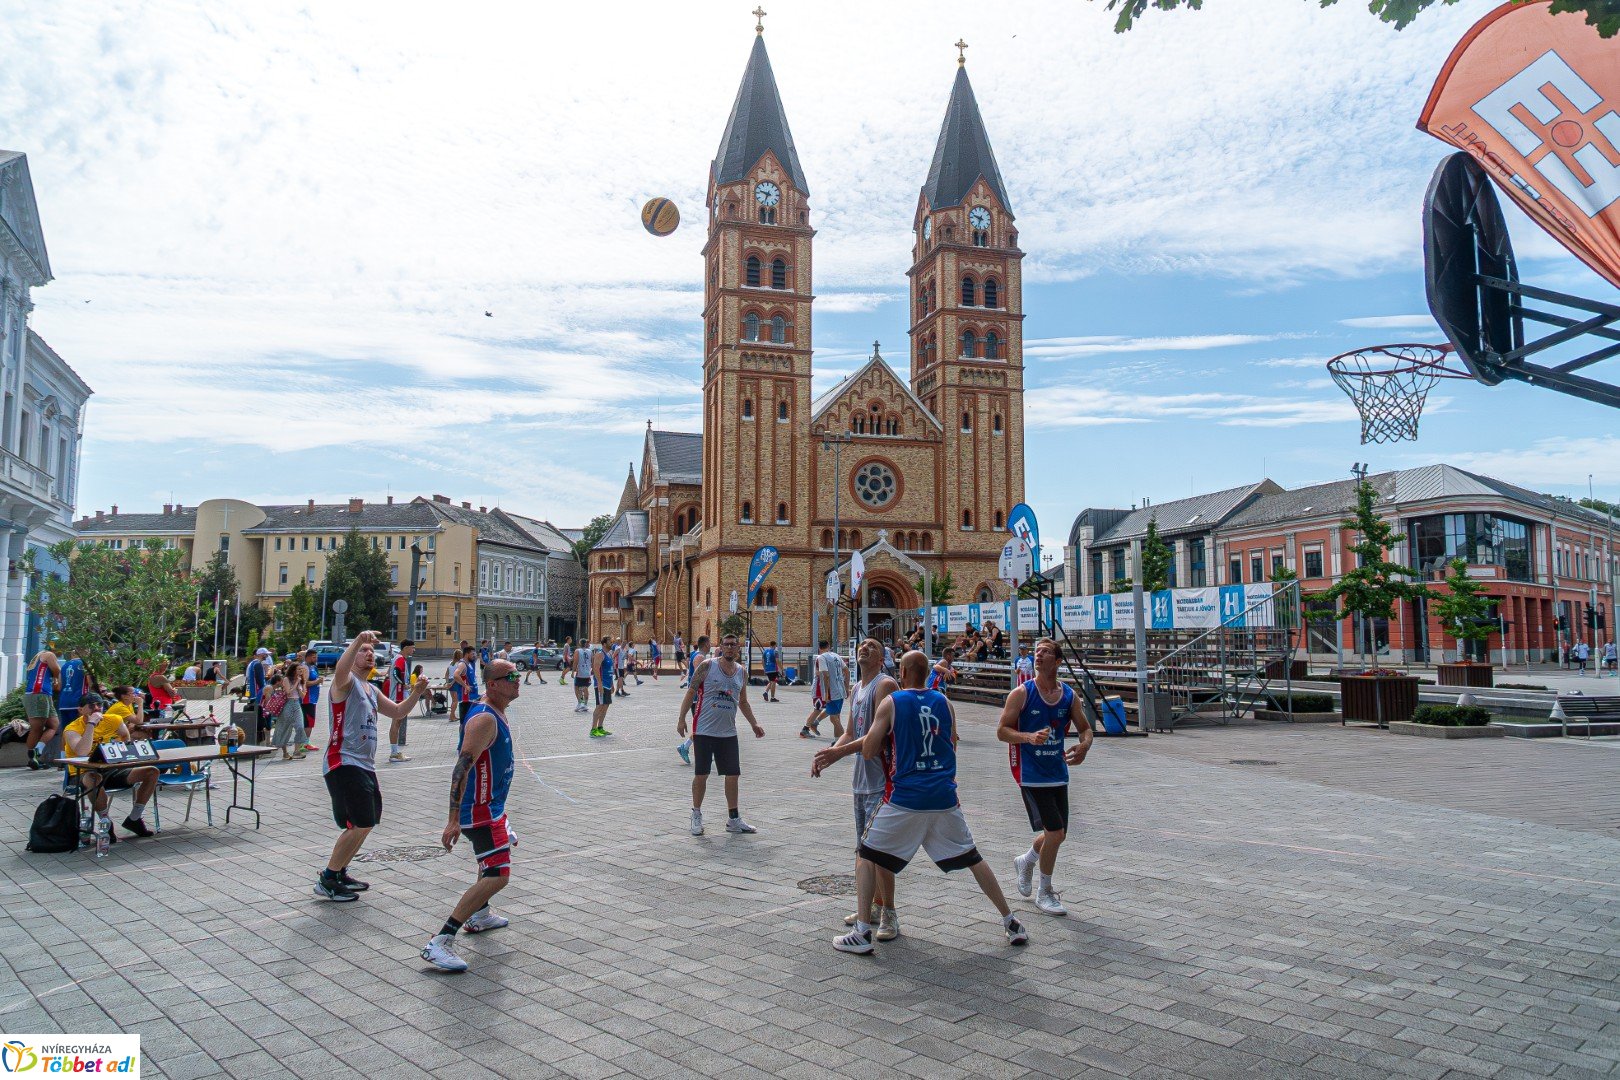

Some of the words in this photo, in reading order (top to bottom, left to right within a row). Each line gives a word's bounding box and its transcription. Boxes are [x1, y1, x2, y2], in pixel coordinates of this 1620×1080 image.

[108, 746, 116, 757] 9
[141, 744, 149, 755] 8
[480, 760, 488, 805] STREETBALL
